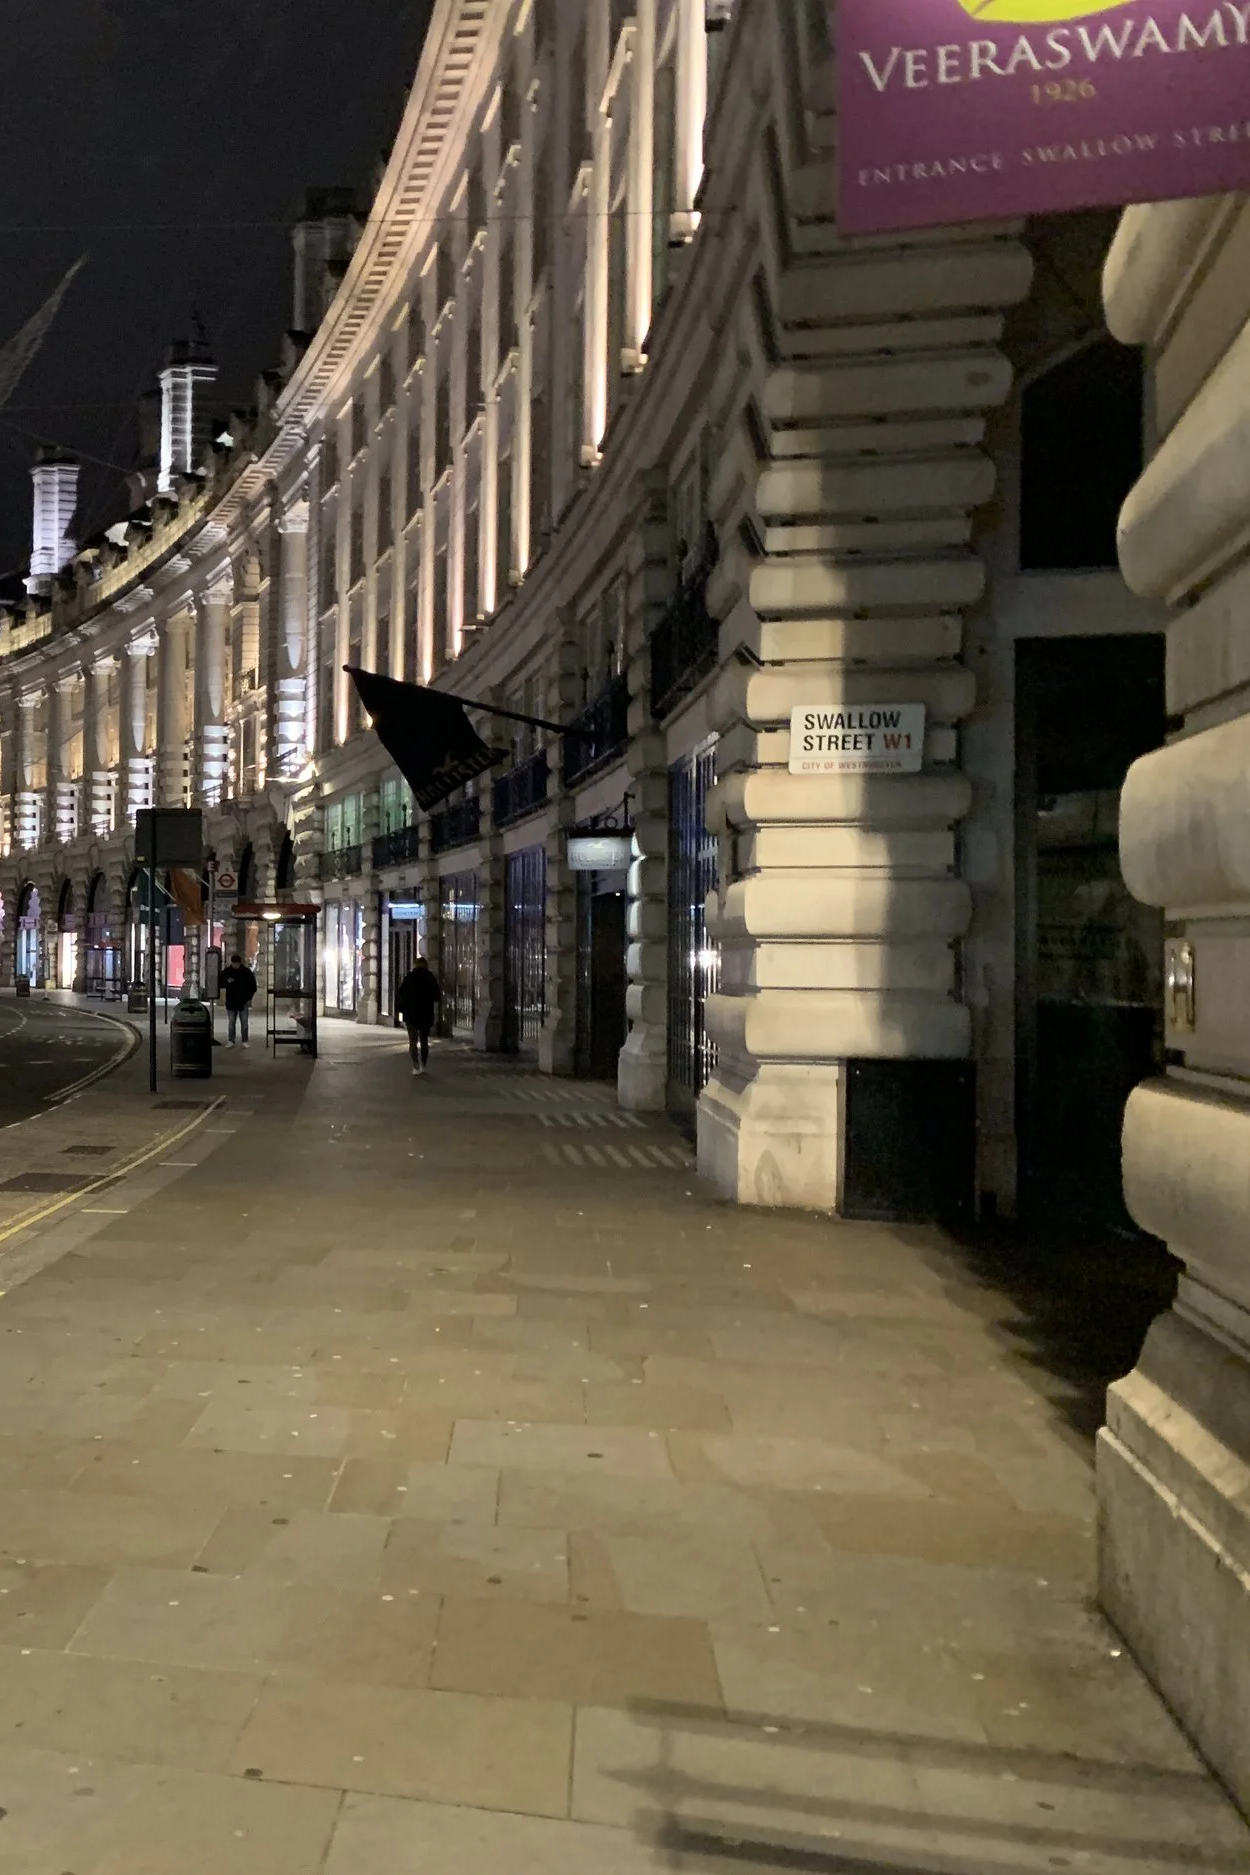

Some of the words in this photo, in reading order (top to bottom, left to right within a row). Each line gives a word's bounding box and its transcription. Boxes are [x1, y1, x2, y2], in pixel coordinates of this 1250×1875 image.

[858, 2, 1250, 92] VEERASWAMY
[1030, 78, 1097, 104] 1926
[858, 151, 1006, 186] ENTRANCE
[1022, 133, 1158, 165] SWALLOW
[1173, 121, 1250, 149] STRE
[805, 711, 901, 730] SWALLOW
[803, 733, 875, 751] STREET
[883, 733, 912, 751] W1
[802, 761, 820, 770] CITY
[824, 761, 835, 770] OF
